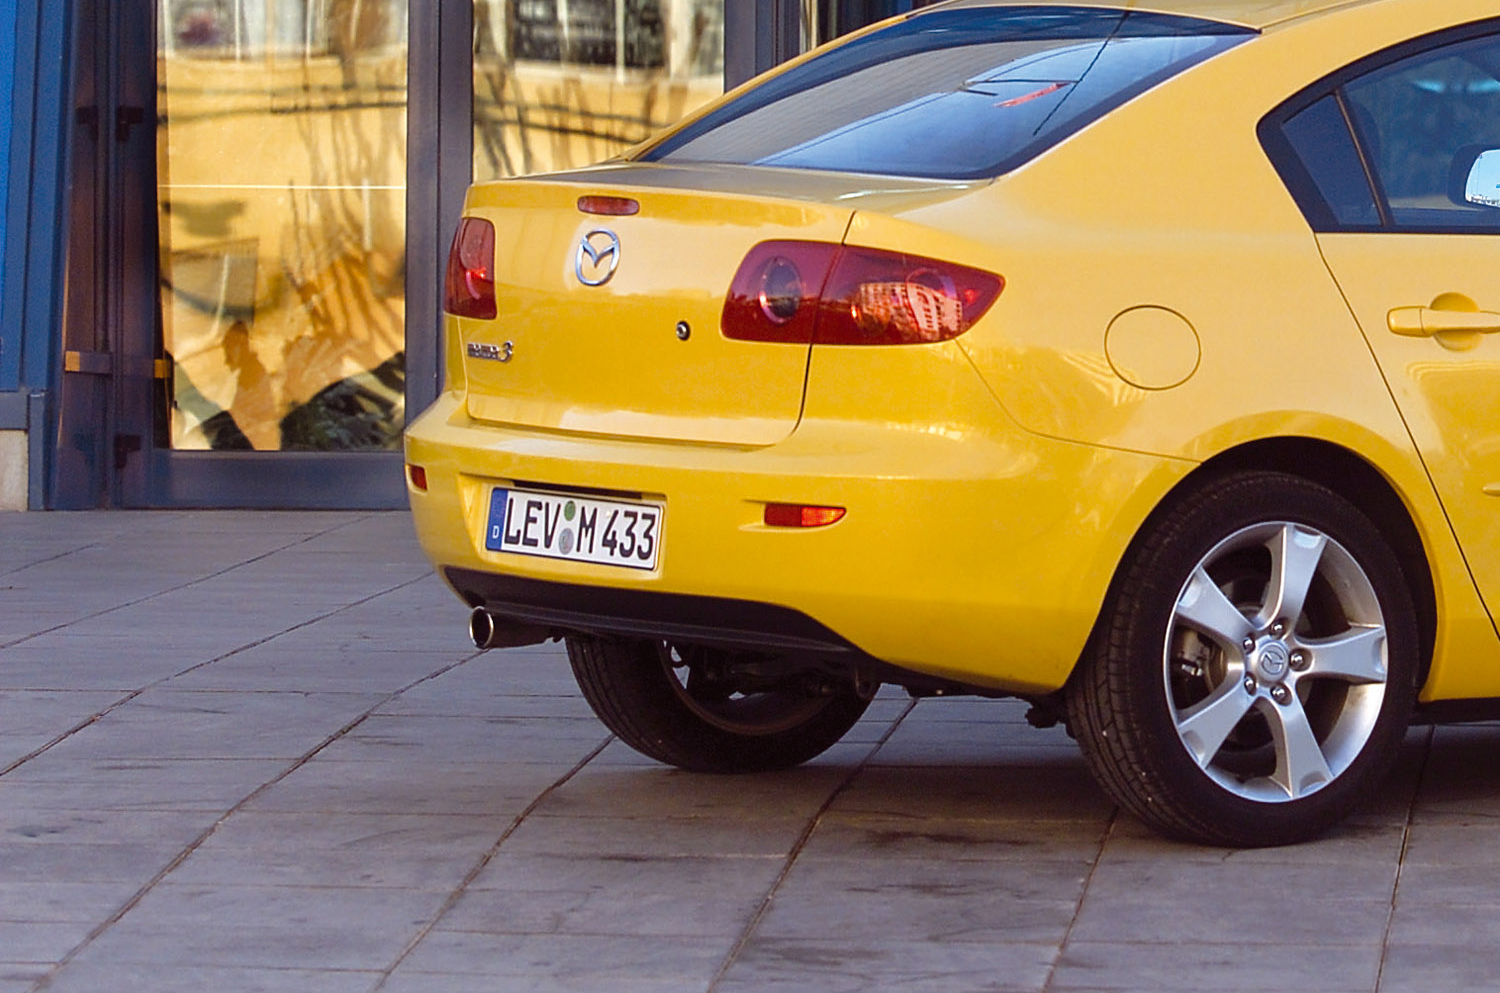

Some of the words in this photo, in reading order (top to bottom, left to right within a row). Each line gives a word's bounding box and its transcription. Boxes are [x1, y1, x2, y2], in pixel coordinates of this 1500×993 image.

[492, 525, 500, 539] D
[504, 497, 561, 549] LEV
[576, 506, 598, 554] M
[601, 509, 656, 561] 433
